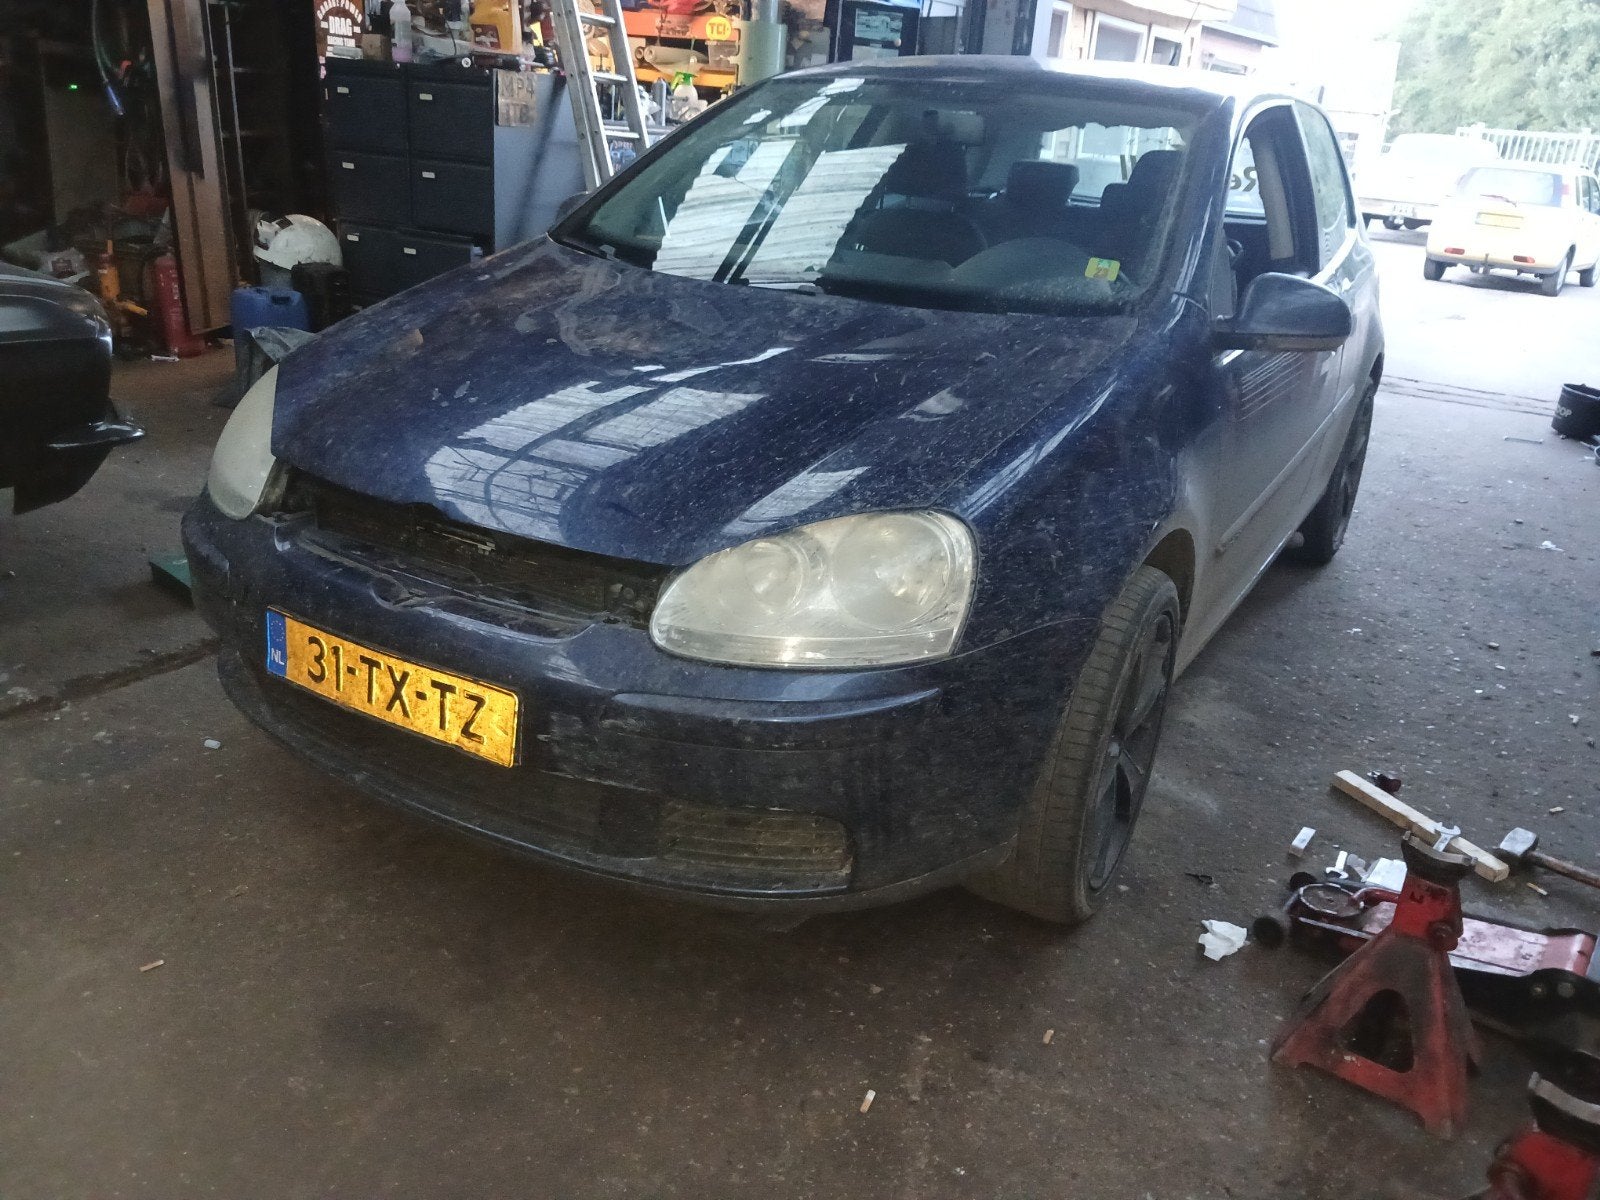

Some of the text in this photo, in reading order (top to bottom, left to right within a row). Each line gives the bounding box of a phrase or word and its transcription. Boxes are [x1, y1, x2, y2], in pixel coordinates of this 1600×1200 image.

[329, 16, 353, 36] DRAG
[271, 647, 285, 666] NL
[307, 635, 488, 745] 31-TX-TZ
